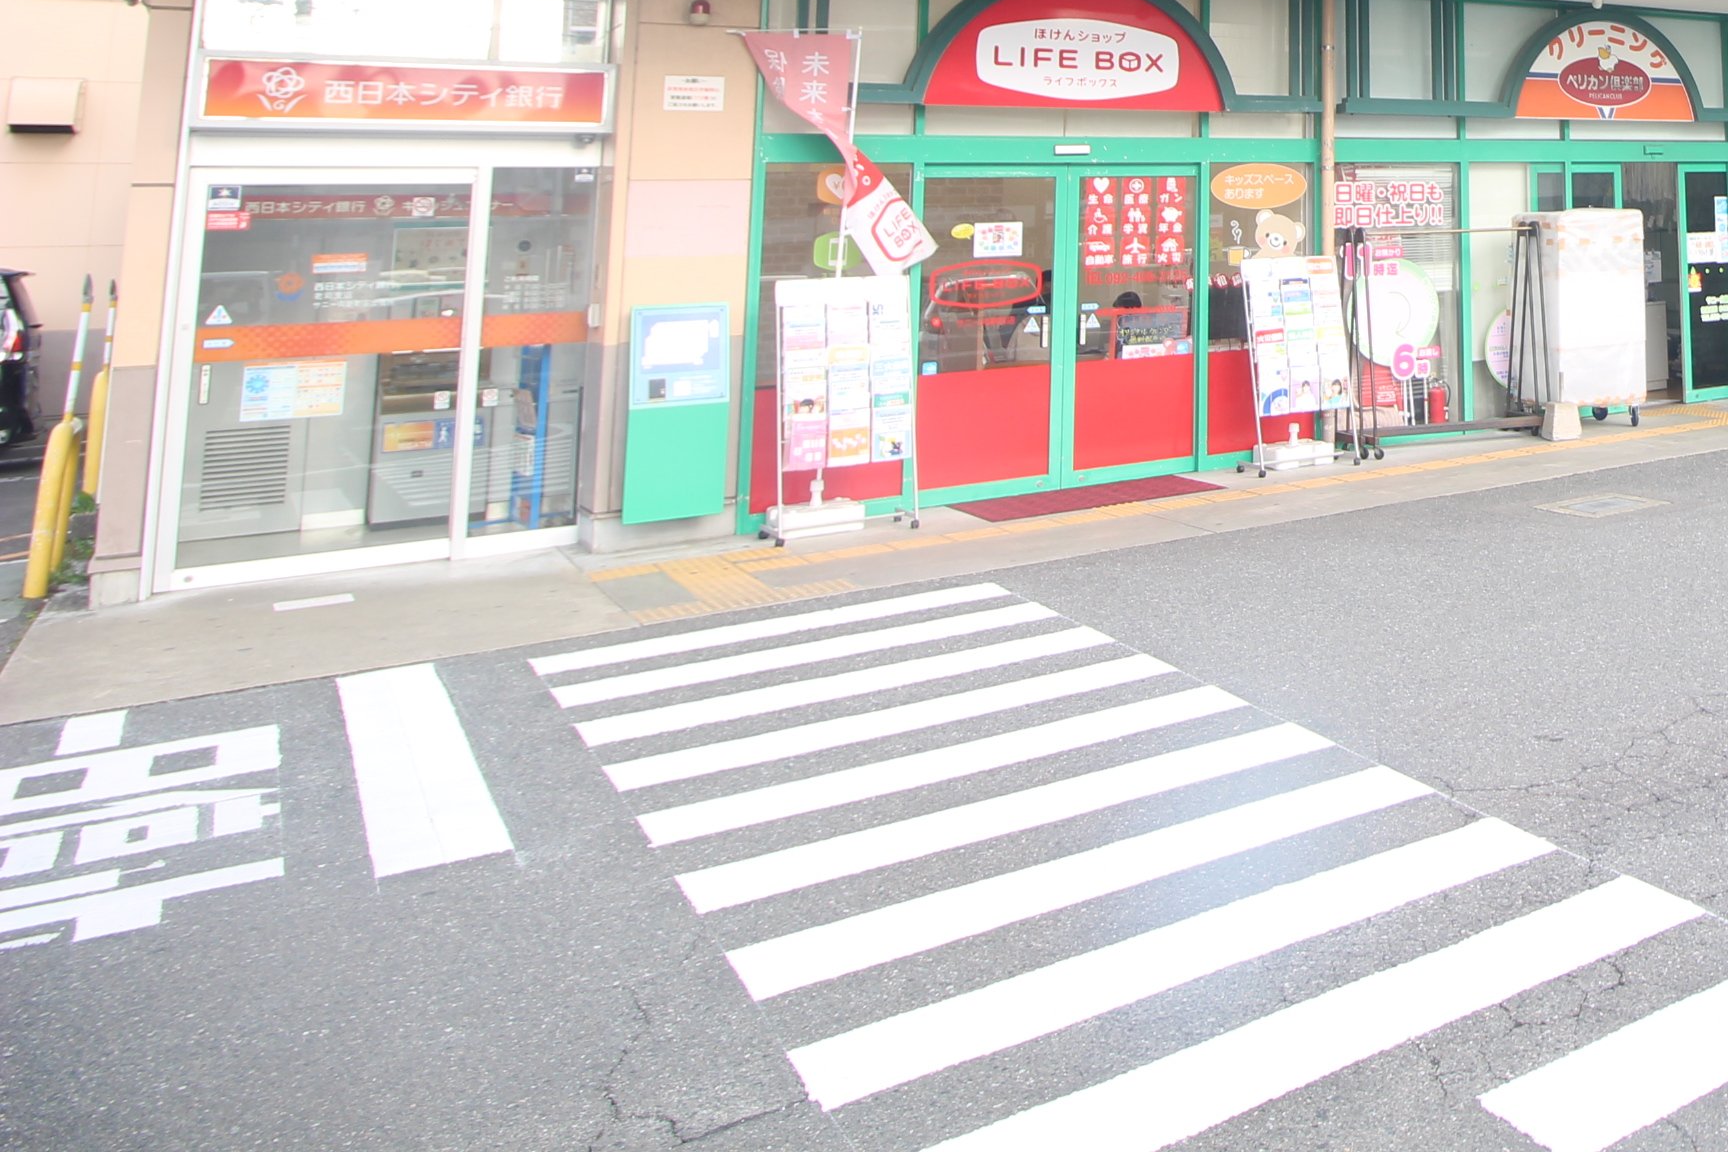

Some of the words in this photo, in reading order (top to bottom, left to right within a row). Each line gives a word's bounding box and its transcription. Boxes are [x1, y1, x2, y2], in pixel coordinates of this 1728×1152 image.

[1034, 27, 1126, 44] ほけんショップ
[1548, 24, 1668, 69] クリーニング
[994, 45, 1078, 69] LIFE
[1094, 51, 1164, 73] BOX
[1042, 76, 1118, 88] ライフボックス
[1566, 73, 1644, 93] ペリカン倶楽部
[324, 81, 563, 110] 西日本シティ銀行
[1224, 173, 1295, 186] キッズスペース
[1088, 193, 1113, 205] 生命
[1160, 192, 1183, 204] ガン
[1224, 188, 1265, 200] あります
[1334, 181, 1444, 204] 日曜・祝日も
[246, 201, 366, 214] 西日本シティ銀行
[883, 208, 912, 238] LIFE
[1334, 204, 1444, 229] 即日仕上り!!
[1158, 222, 1183, 233] 年金
[1085, 254, 1114, 266] 自動車
[1122, 253, 1148, 265] 旅行
[1393, 343, 1416, 380] 6
